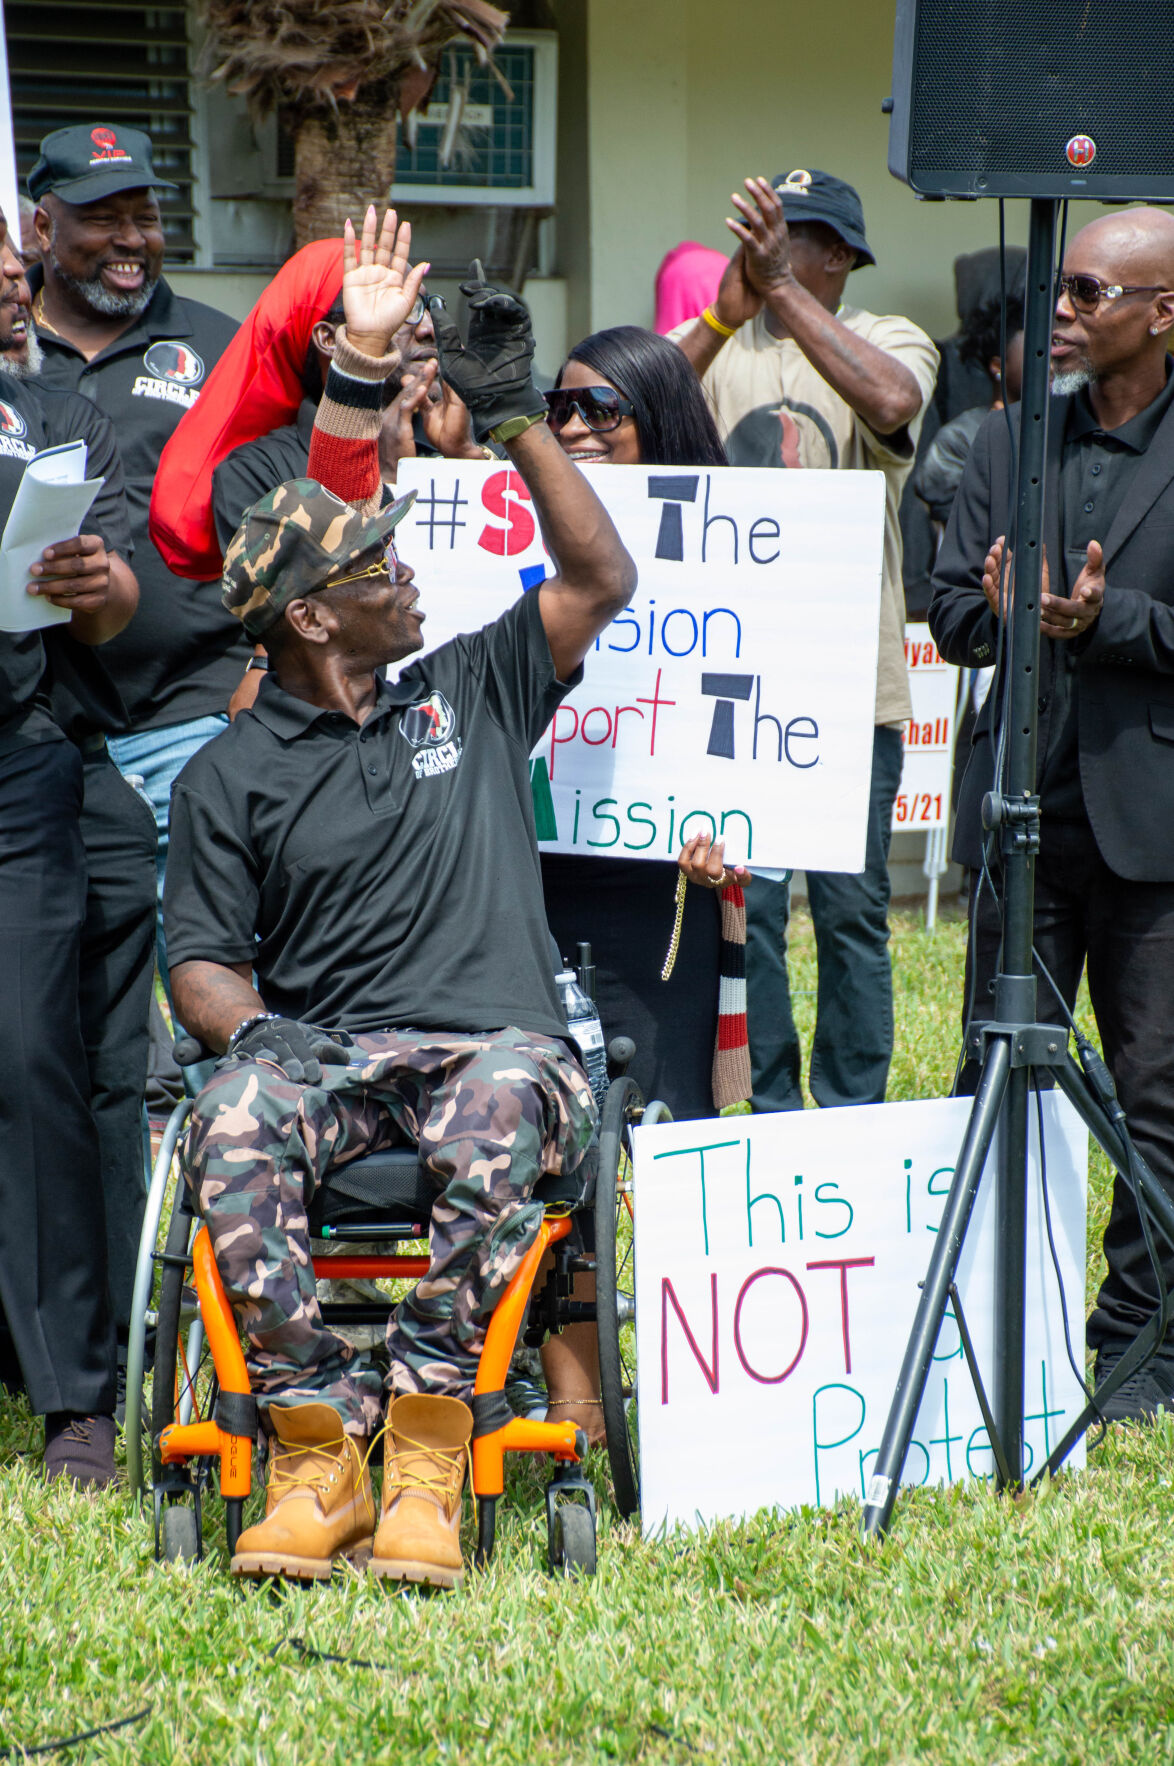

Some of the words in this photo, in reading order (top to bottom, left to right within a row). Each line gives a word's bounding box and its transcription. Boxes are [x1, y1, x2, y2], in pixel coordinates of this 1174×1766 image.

[91, 149, 126, 159] VIP
[415, 469, 550, 558] #S
[648, 474, 780, 565] The
[411, 737, 463, 771] CIRCL
[541, 668, 676, 781] port
[701, 672, 820, 769] The
[902, 717, 949, 745] hall
[654, 1138, 854, 1256] This
[904, 1158, 957, 1233] is
[661, 1256, 875, 1405] NOT
[230, 1434, 238, 1479] OGUE
[813, 1360, 1066, 1507] Protet
